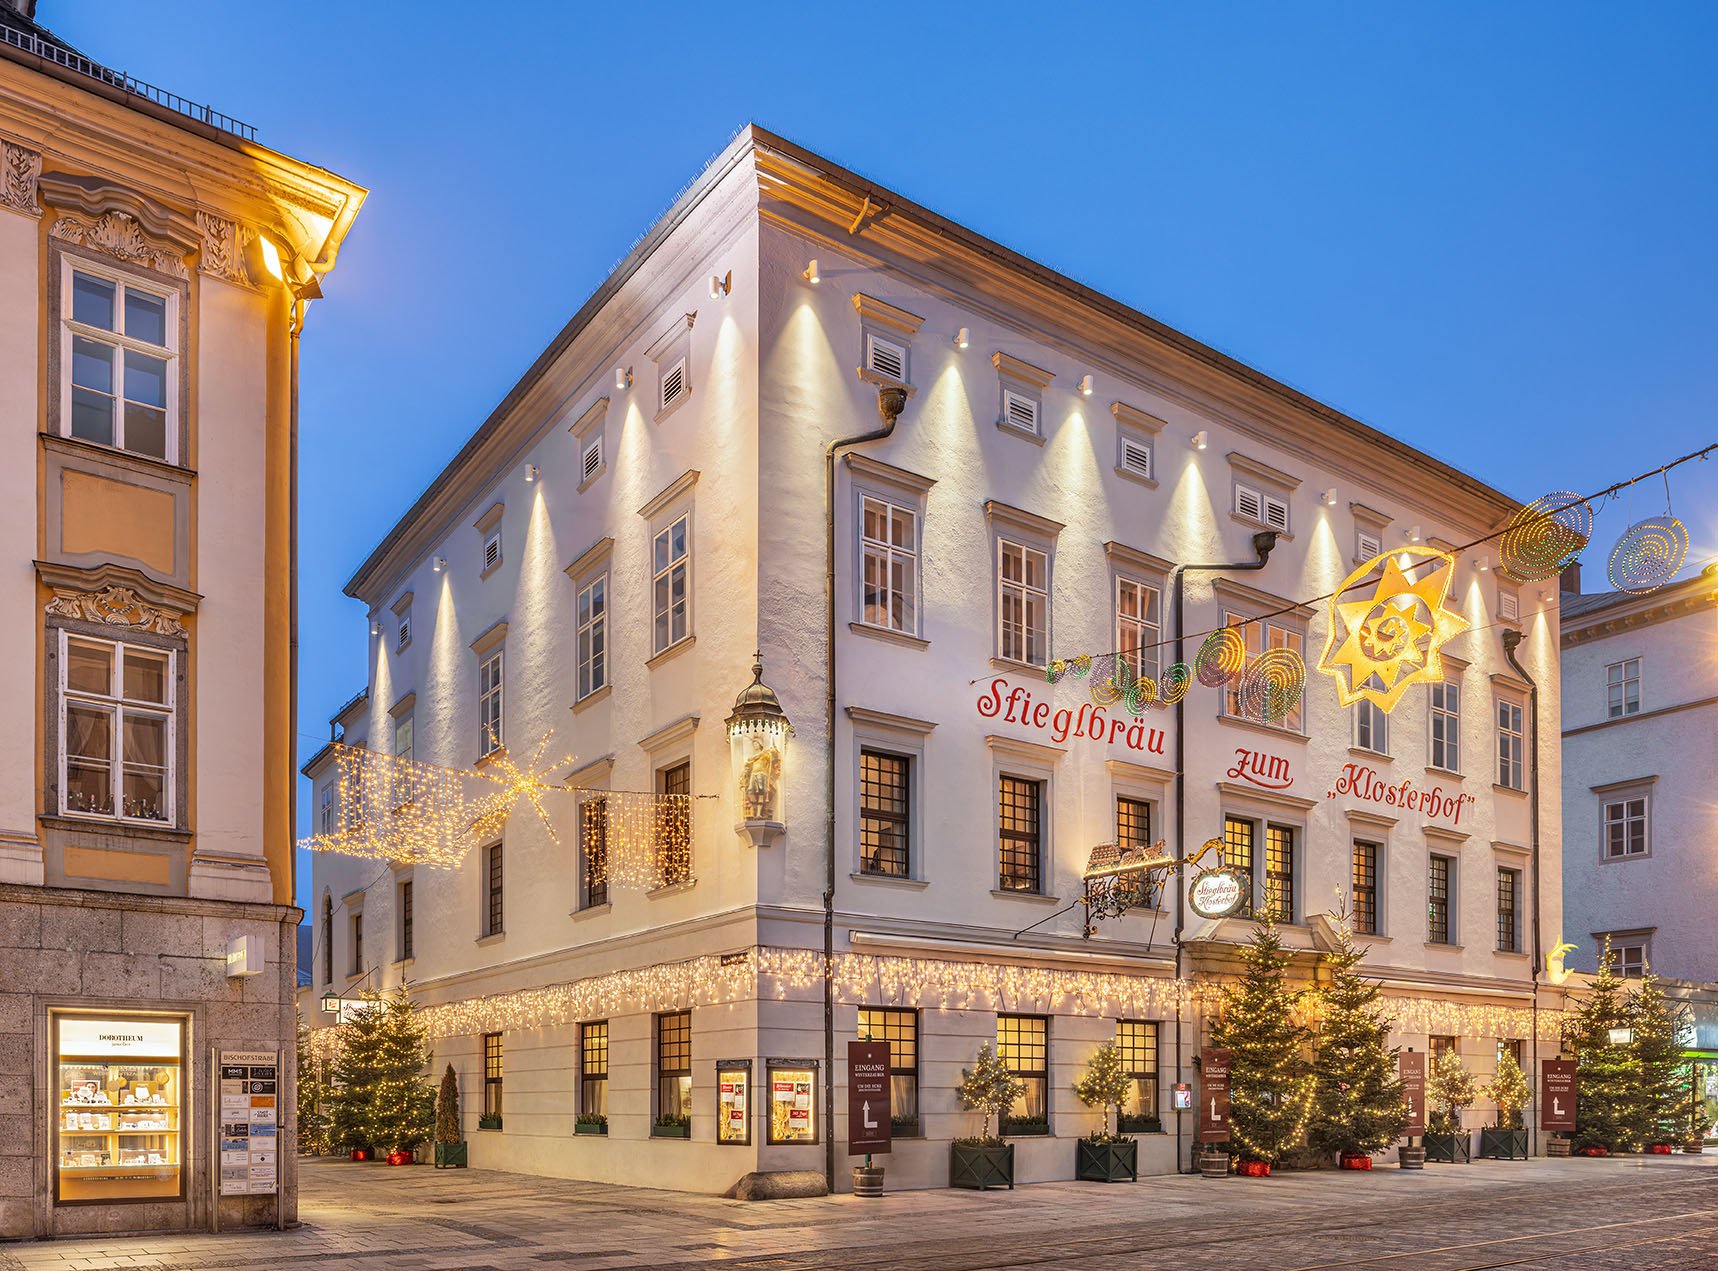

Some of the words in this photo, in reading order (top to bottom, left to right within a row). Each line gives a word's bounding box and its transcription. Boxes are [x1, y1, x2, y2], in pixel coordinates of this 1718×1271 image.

[976, 678, 1165, 756] Stieglbräu
[1197, 881, 1237, 896] Stieglbräu
[1198, 894, 1238, 910] Klosterhof
[99, 1034, 144, 1042] DOROTHEUM
